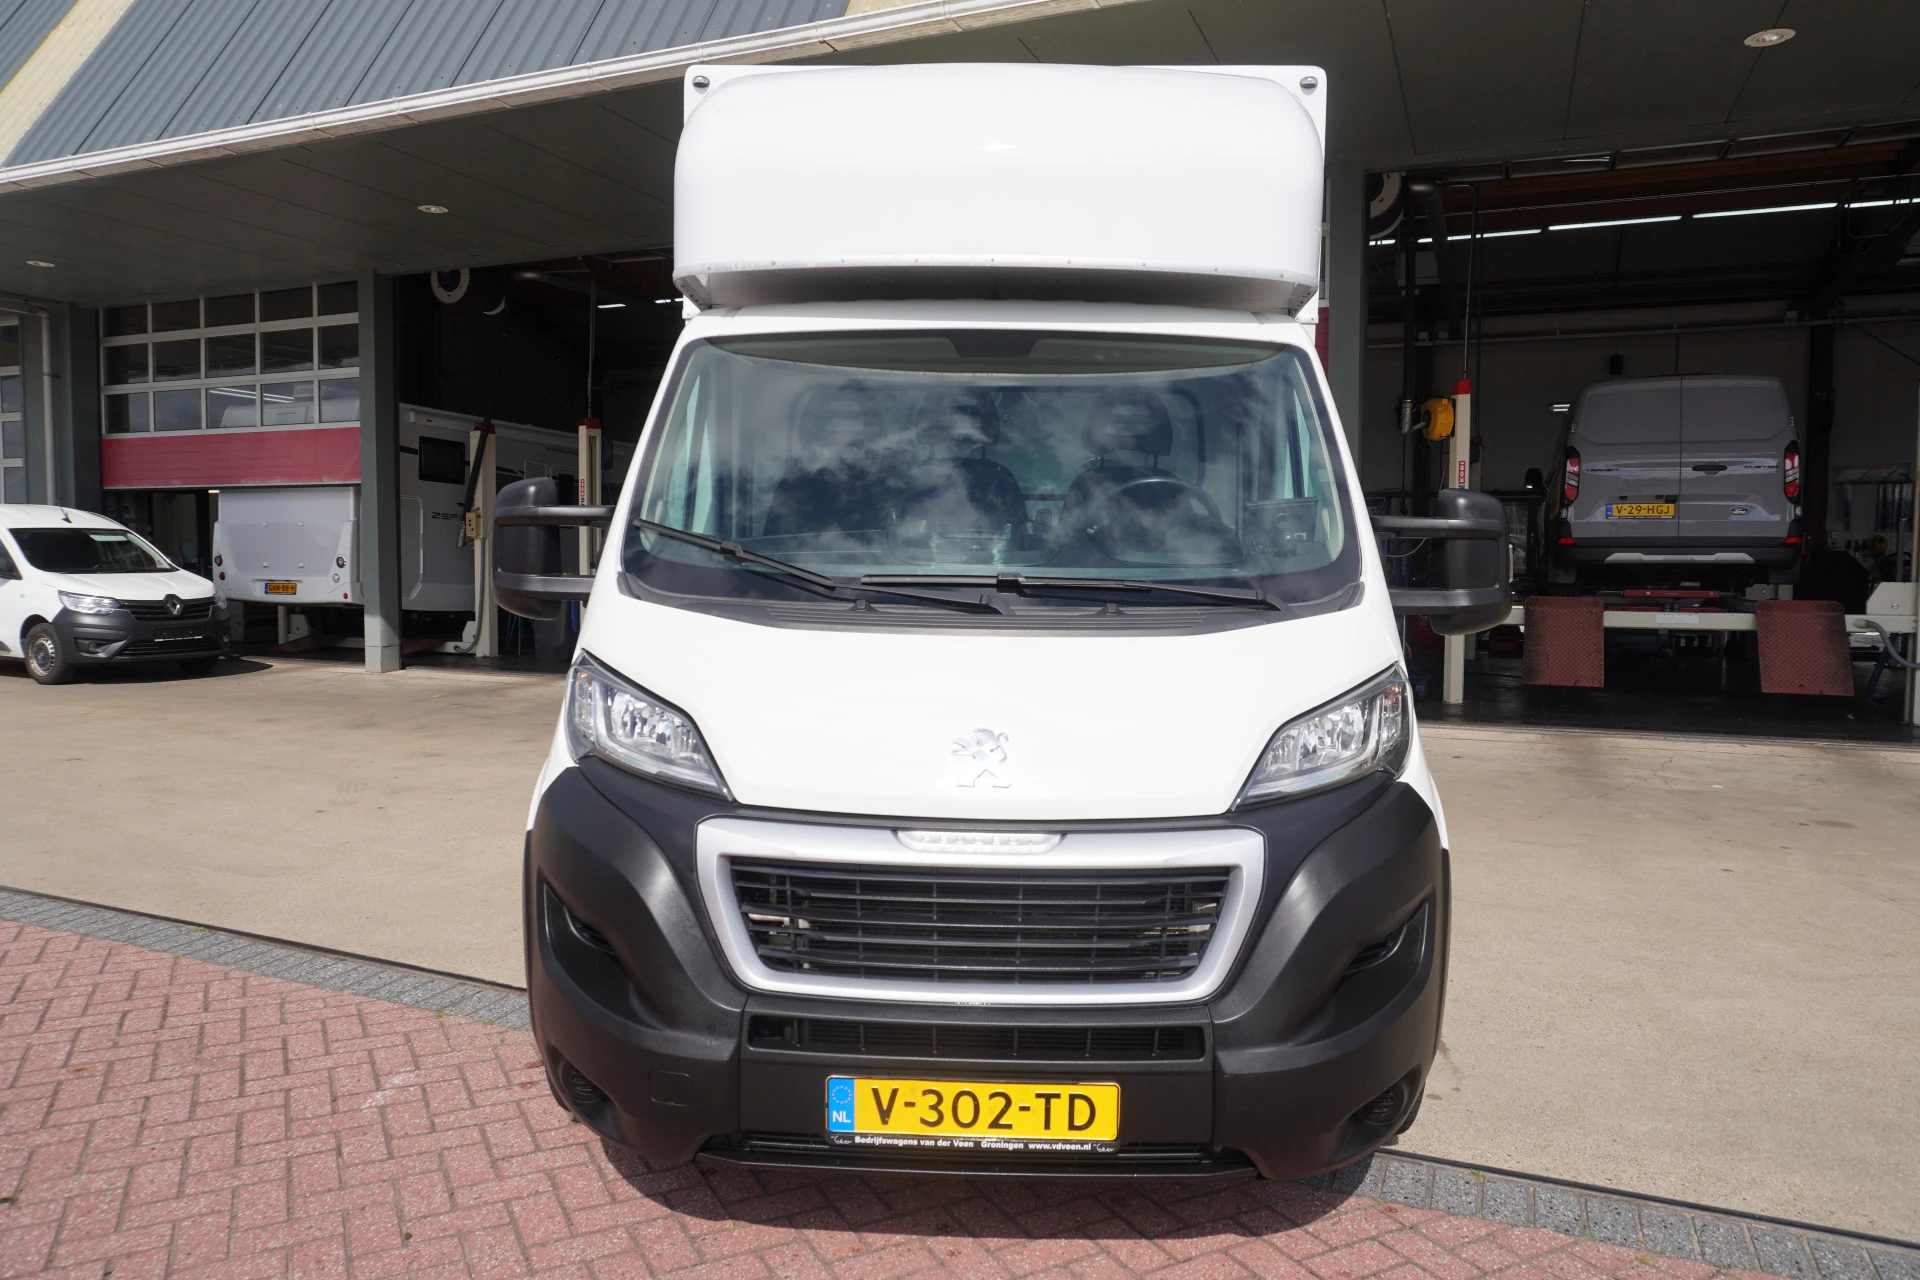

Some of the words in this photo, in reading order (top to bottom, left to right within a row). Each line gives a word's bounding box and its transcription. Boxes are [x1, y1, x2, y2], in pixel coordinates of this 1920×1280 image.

[431, 511, 463, 521] ZEFI
[1616, 505, 1670, 515] V-29-HGJ
[921, 834, 1037, 846] PEUGEOT
[871, 1086, 1096, 1131] V-302-TD
[832, 1110, 851, 1123] NL
[854, 1136, 918, 1146] Bedrijfswagens
[920, 1138, 935, 1146] van
[937, 1138, 951, 1147] der
[953, 1138, 974, 1147] Veen
[981, 1141, 1024, 1150] Groningen
[1028, 1142, 1091, 1151] www.vdveen.nl
